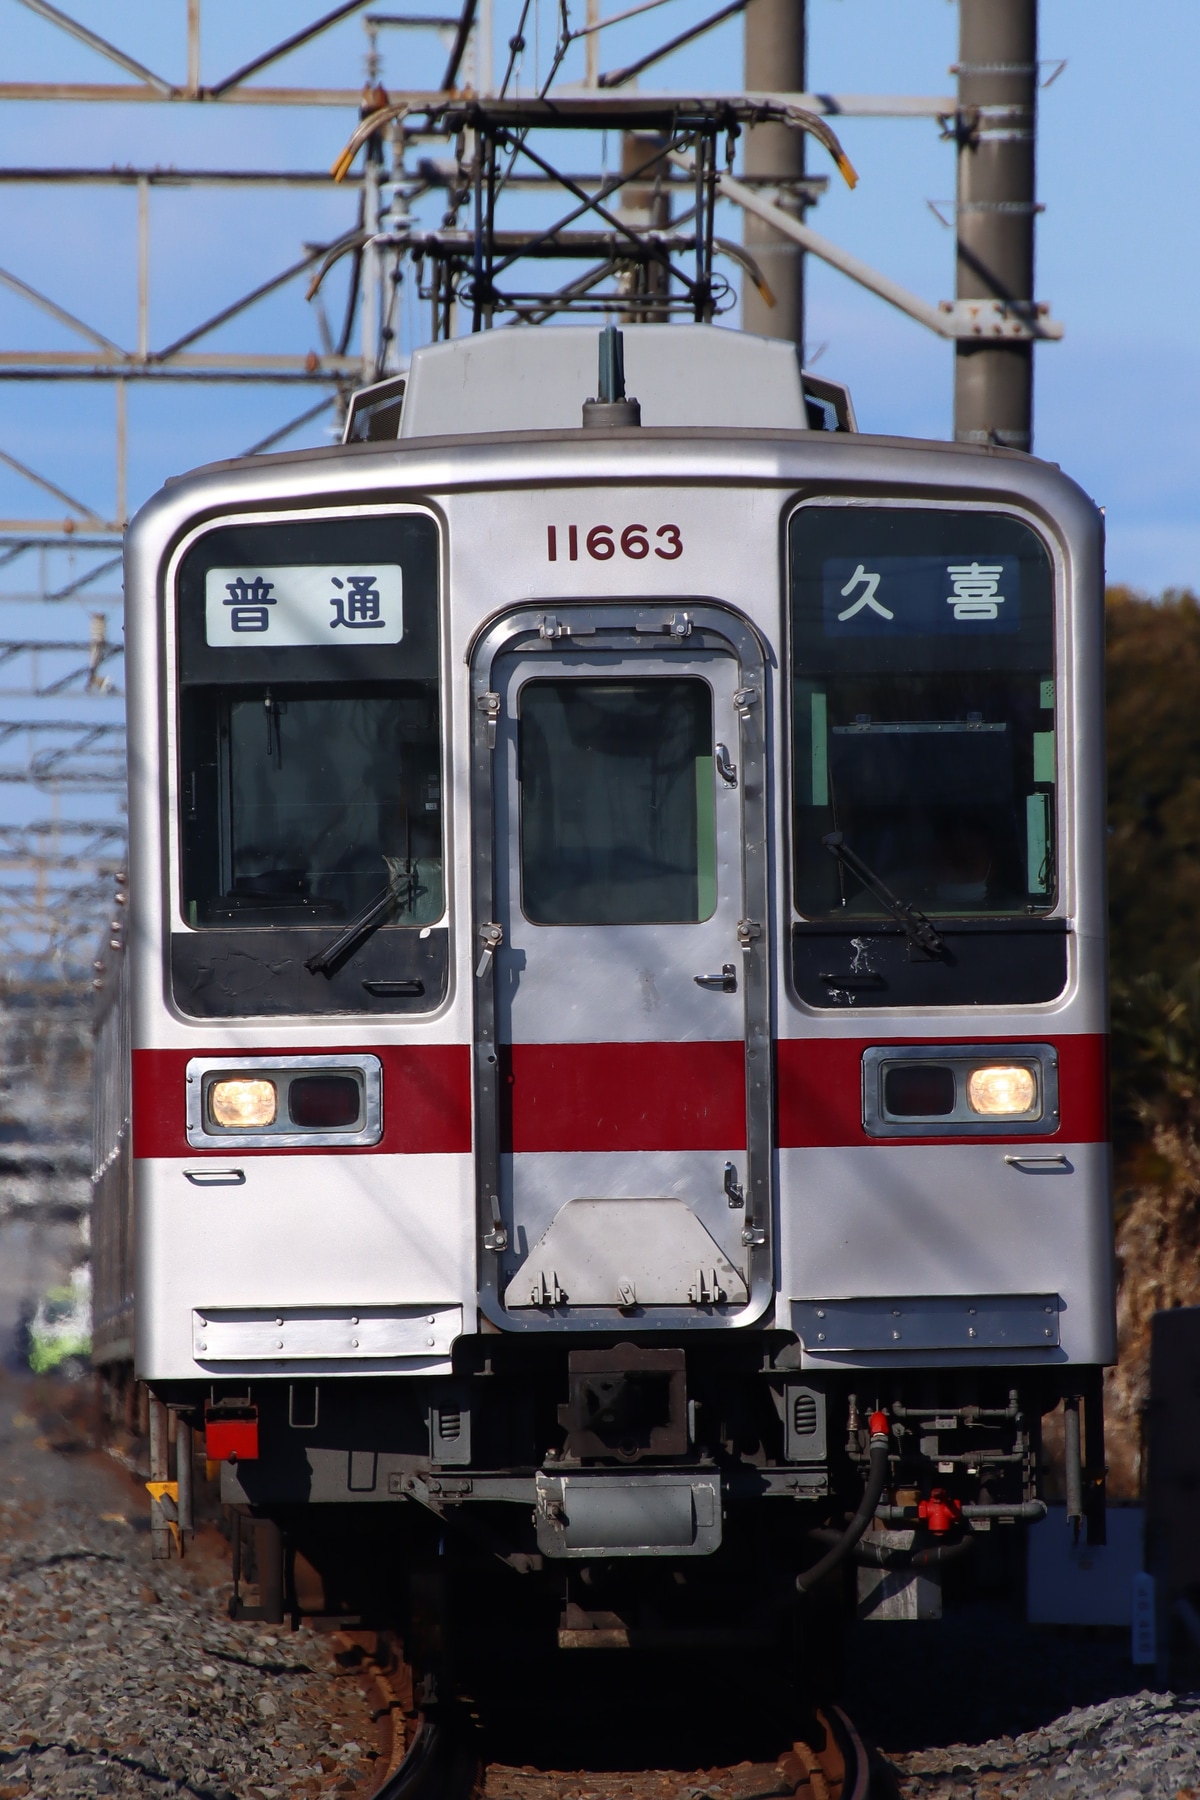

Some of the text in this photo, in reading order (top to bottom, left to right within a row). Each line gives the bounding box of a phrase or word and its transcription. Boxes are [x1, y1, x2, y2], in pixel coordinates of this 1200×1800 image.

[547, 525, 683, 561] 11663
[222, 576, 386, 633] 普通
[837, 562, 1006, 621] 久喜
